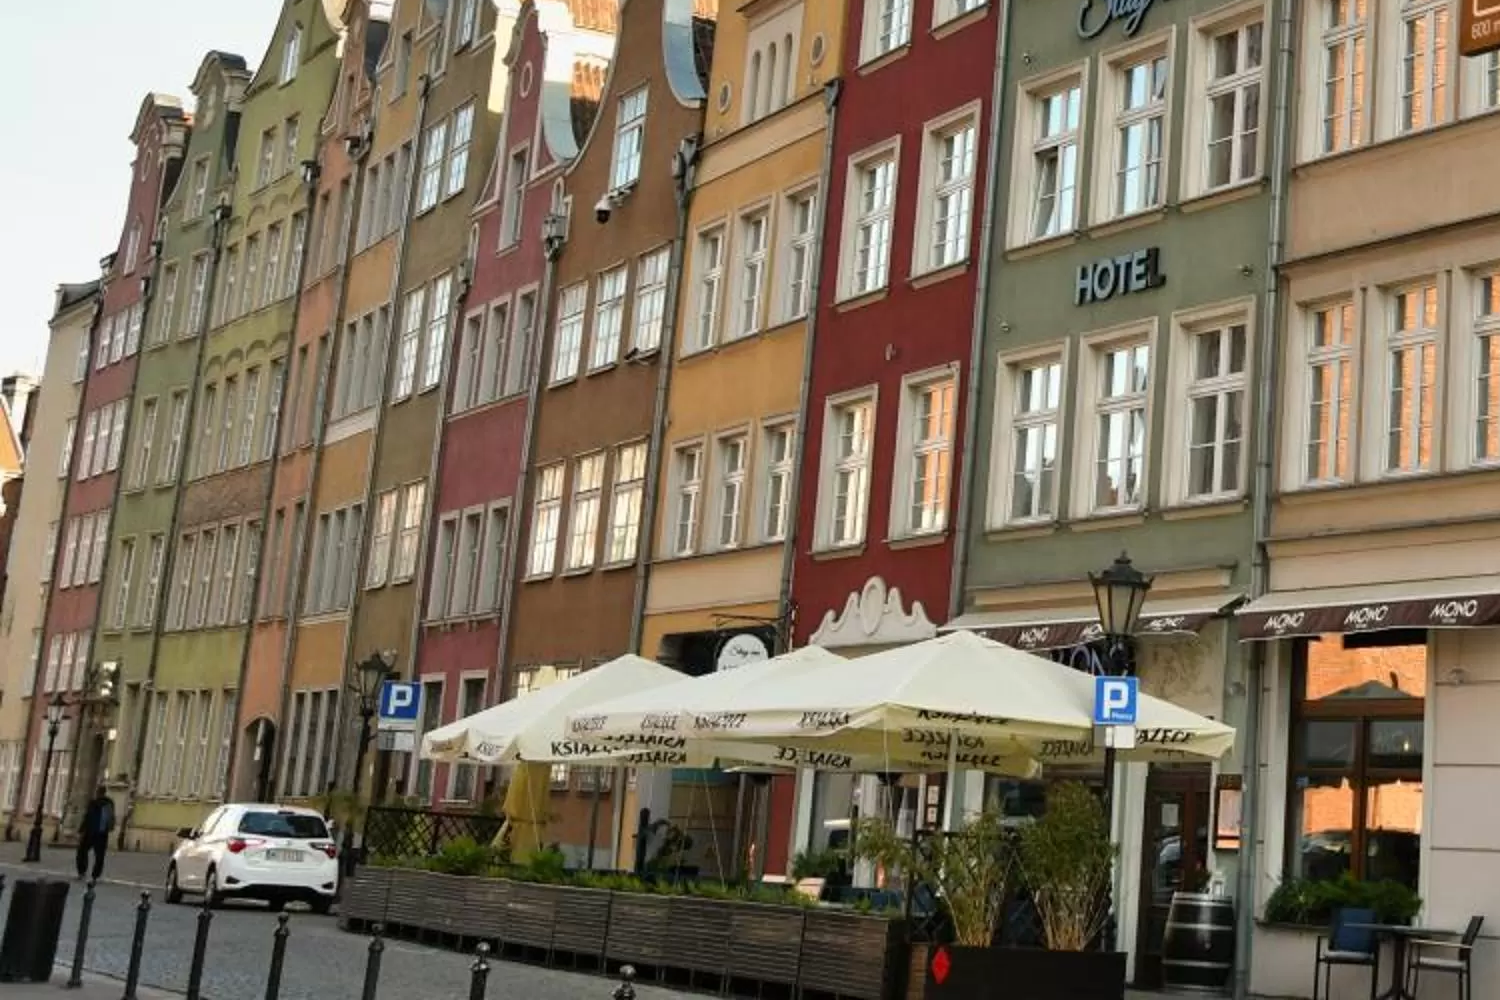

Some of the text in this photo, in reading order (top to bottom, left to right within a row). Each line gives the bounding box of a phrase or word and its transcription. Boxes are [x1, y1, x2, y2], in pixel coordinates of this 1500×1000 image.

[1074, 246, 1167, 306] HOTEL
[1344, 605, 1390, 625] MONO
[1428, 599, 1479, 619] MONO
[1263, 611, 1305, 630] MONO
[1017, 626, 1050, 644] MONO
[387, 683, 413, 715] P
[1103, 681, 1129, 719] P
